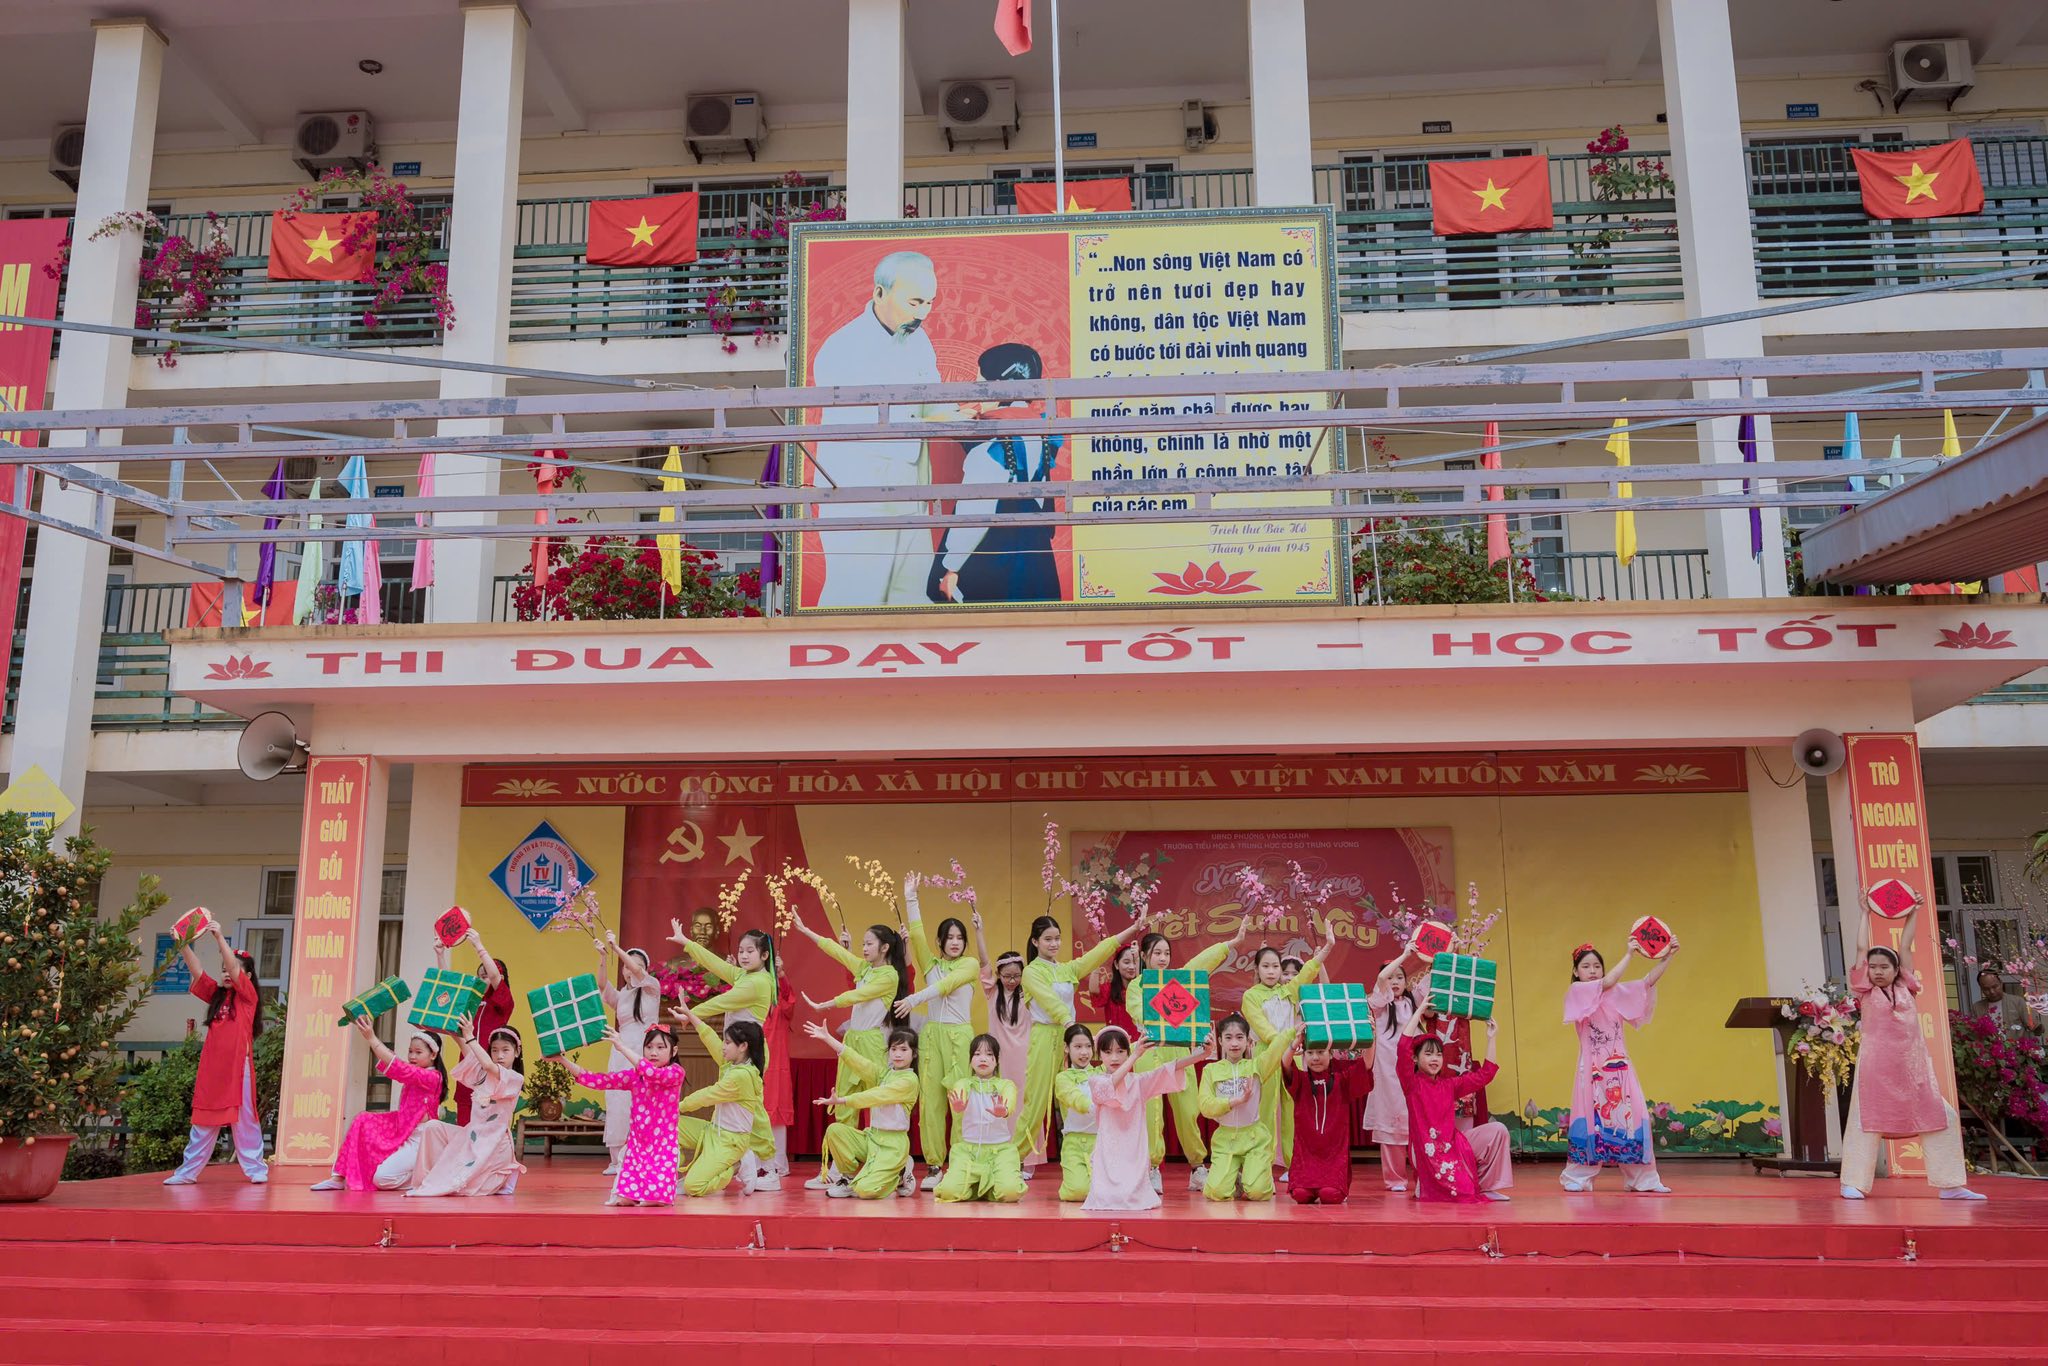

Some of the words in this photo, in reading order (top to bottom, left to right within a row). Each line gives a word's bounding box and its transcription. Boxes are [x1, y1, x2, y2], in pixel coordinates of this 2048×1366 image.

[347, 127, 358, 135] LG
[1152, 252, 1193, 272] sông
[1198, 252, 1231, 272] Việt
[1237, 251, 1276, 268] Nam
[1282, 249, 1304, 267] có
[1088, 284, 1116, 303] trở
[1128, 282, 1162, 301] nên
[1174, 282, 1212, 300] tươi
[1224, 281, 1259, 301] đẹp
[1271, 279, 1306, 299] hay
[1089, 314, 1146, 333] không,
[1154, 311, 1185, 330] dân
[1192, 311, 1219, 332] tộc
[1227, 310, 1260, 331] Việt
[1267, 309, 1306, 327] Nam
[1090, 343, 1110, 362] có
[1114, 343, 1155, 361] bước
[1159, 341, 1181, 360] tới
[1185, 341, 1211, 359] đài
[1215, 341, 1251, 359] vinh
[1255, 341, 1308, 359] quang
[1091, 434, 1148, 454] không,
[1213, 431, 1229, 450] là
[1238, 431, 1270, 450] nhờ
[1278, 430, 1312, 452] một
[1263, 522, 1285, 534] Bác
[1208, 543, 1245, 556] Tháng
[1248, 543, 1255, 553] 9
[1257, 542, 1281, 553] năm
[1286, 542, 1311, 553] 1945
[306, 650, 444, 676] THI
[510, 645, 714, 672] ĐUA
[788, 641, 982, 674] DẠY
[1066, 626, 1246, 663] TỐT
[1431, 630, 1633, 663] HỌC
[1697, 614, 1897, 652] TỐT
[575, 771, 667, 795] NƯỚC
[680, 770, 774, 800] CỘNG
[787, 770, 864, 793] HÒA
[874, 767, 924, 792] XÃ
[935, 767, 1002, 797] HỘI
[1014, 763, 1087, 790] CHỦ
[1099, 764, 1218, 789] NGHĨA
[1229, 763, 1313, 793] VIỆT
[1323, 766, 1403, 787] NAM
[1416, 763, 1523, 785] MUÔN
[1535, 761, 1618, 784] NĂM
[1868, 755, 1900, 786] TRÒ
[1861, 802, 1917, 827] NGOAN
[320, 812, 348, 842] GIỎI
[1868, 838, 1919, 874] LUYỆN
[533, 867, 550, 880] TV
[305, 930, 345, 959] NHÂN
[311, 969, 334, 998] TÀI
